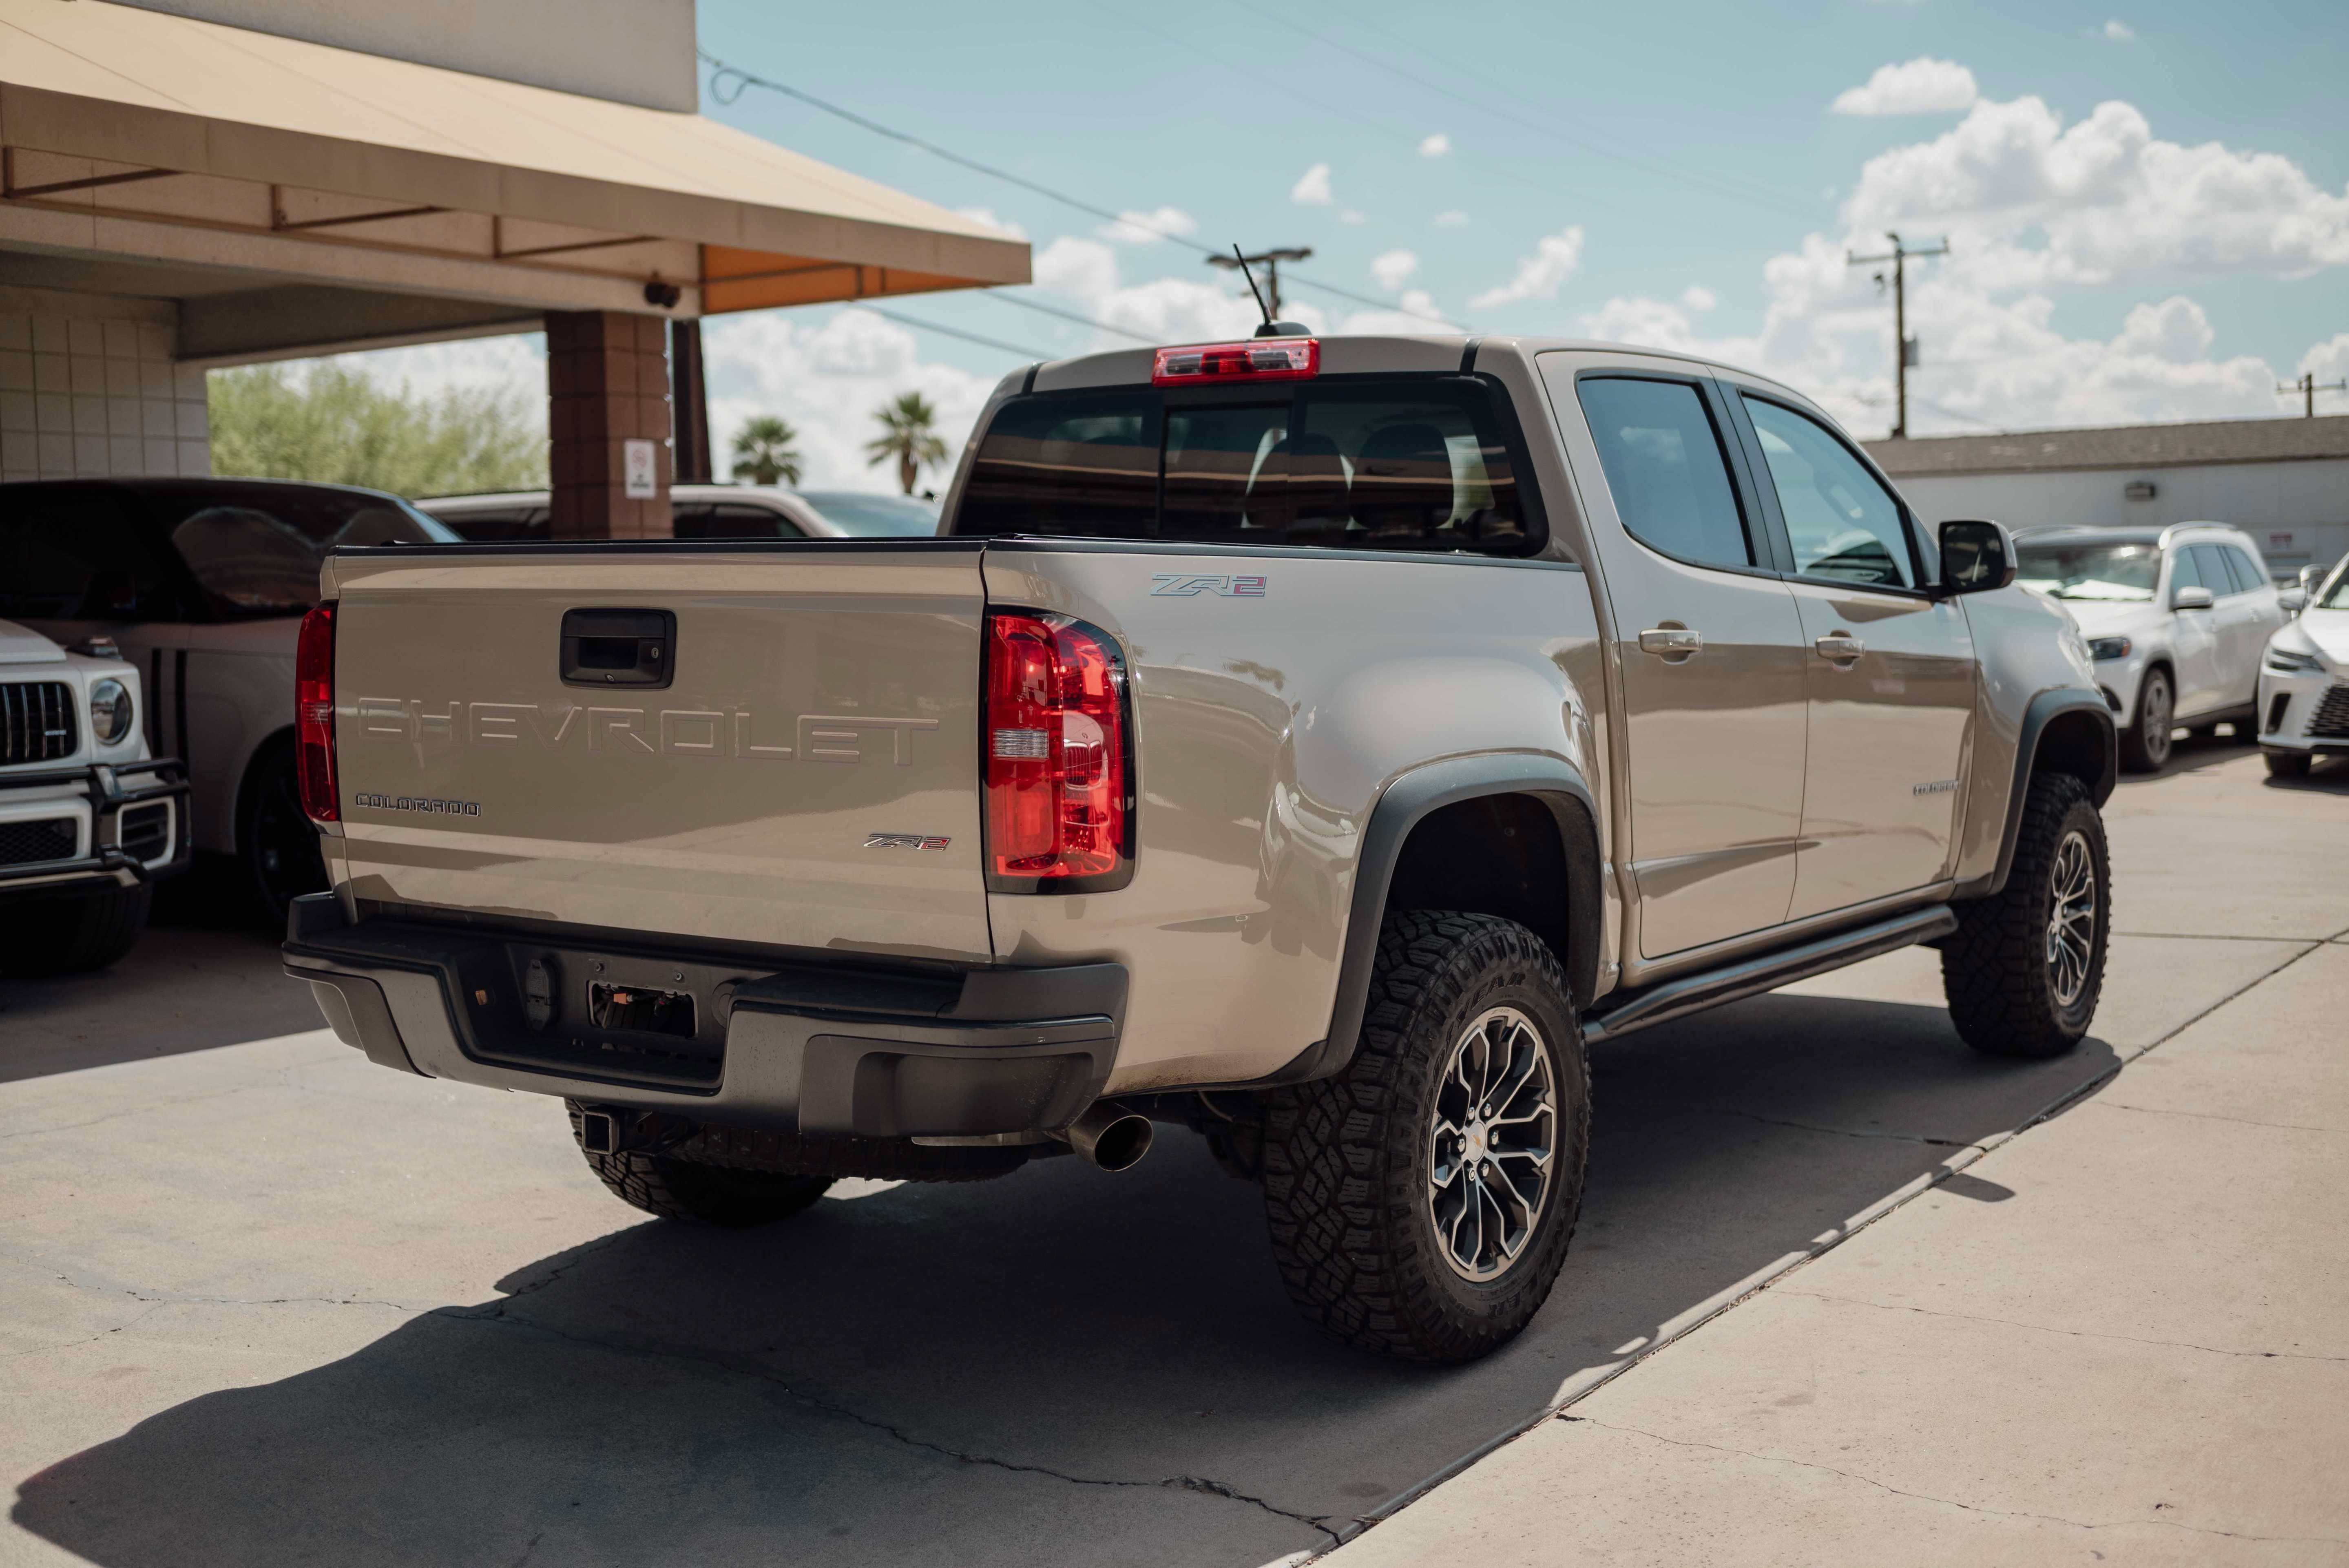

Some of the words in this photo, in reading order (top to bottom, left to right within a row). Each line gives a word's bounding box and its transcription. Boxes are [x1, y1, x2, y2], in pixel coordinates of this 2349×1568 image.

[1150, 572, 1267, 597] ZR2
[358, 698, 938, 766] CHEVROLET
[356, 793, 481, 817] COLORADO
[863, 834, 951, 851] ZR2
